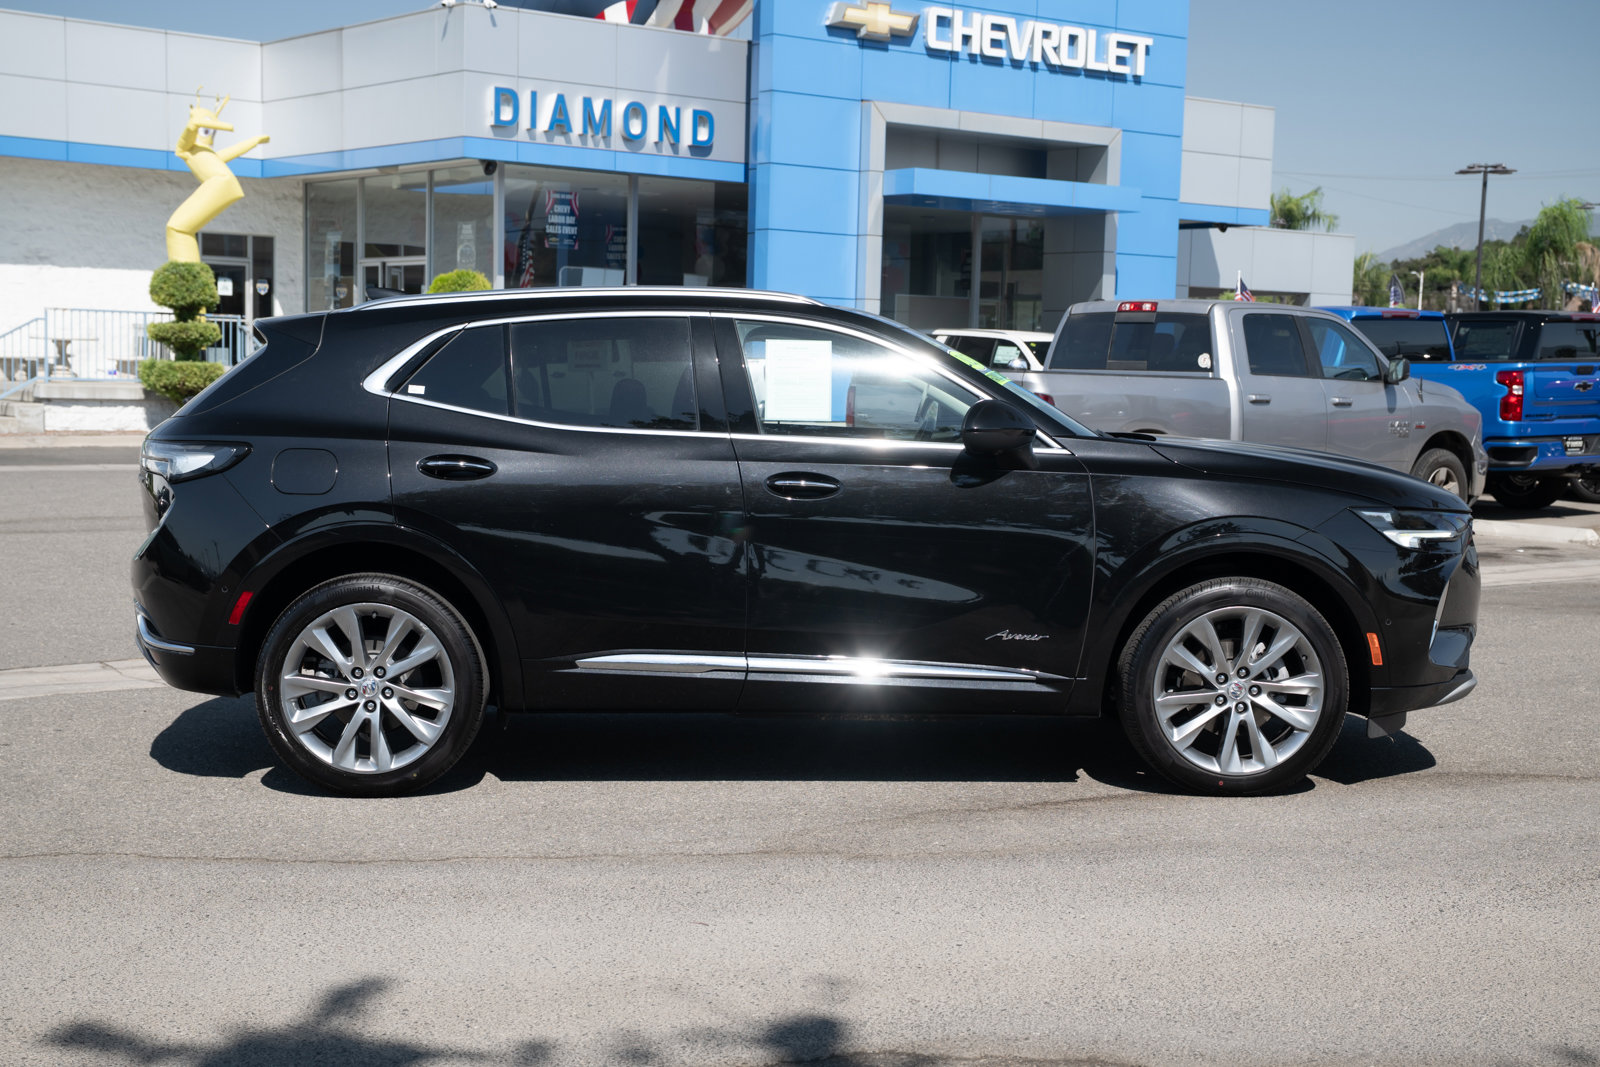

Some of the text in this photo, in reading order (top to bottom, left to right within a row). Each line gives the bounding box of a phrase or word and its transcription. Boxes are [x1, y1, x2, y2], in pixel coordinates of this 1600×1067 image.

[925, 6, 1154, 77] CHEVROLET
[494, 86, 715, 146] DIAMOND
[554, 205, 571, 213] CHEVY
[548, 215, 576, 224] LABOR DAY
[546, 225, 578, 235] SALES EVENT
[985, 629, 1050, 641] Avenir
